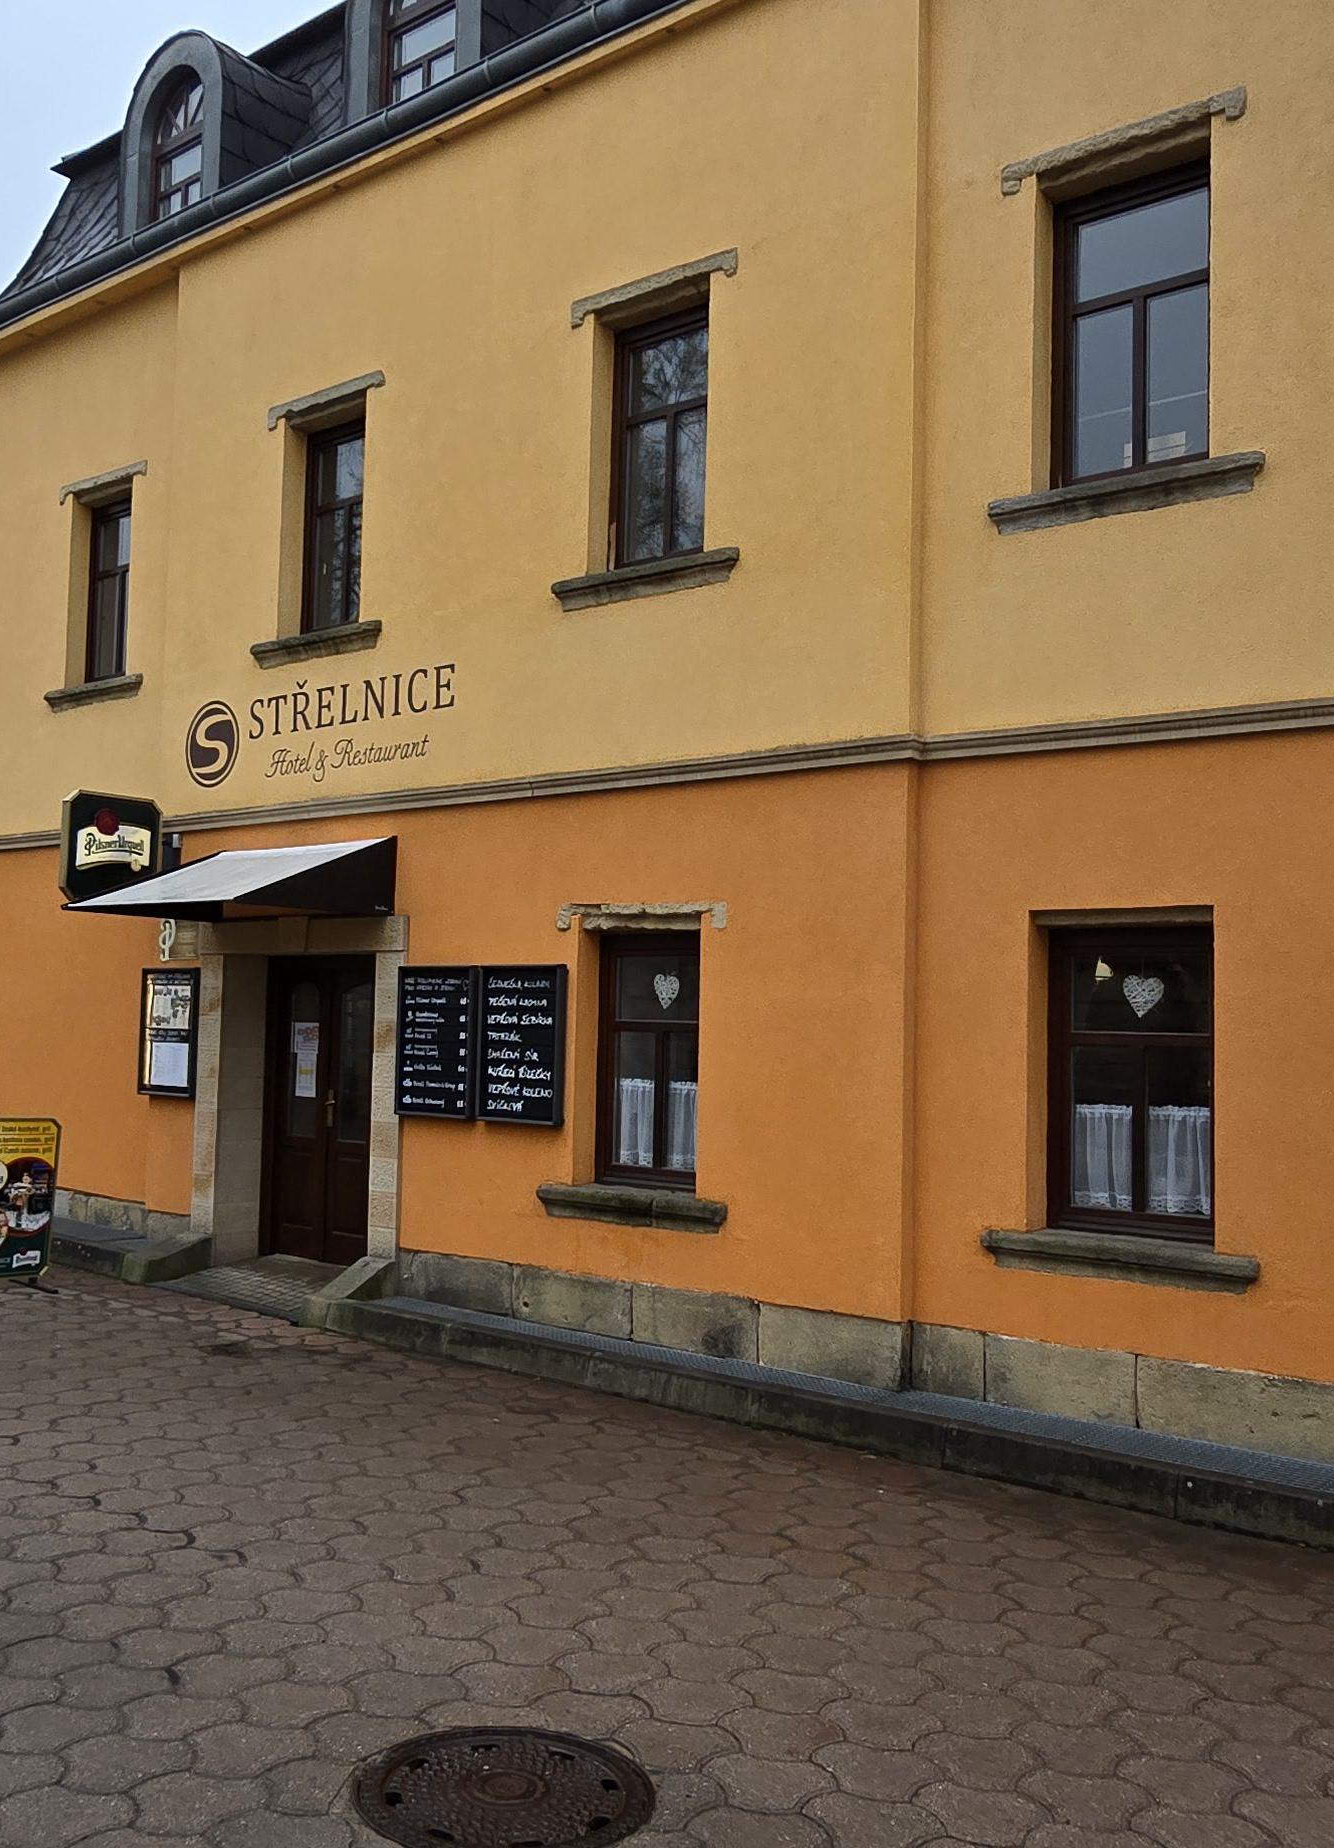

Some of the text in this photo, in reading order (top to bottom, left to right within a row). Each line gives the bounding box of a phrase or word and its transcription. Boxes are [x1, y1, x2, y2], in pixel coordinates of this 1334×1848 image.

[249, 664, 455, 739] STŘELNICE
[265, 734, 429, 782] Hotel & Restaurant
[84, 833, 144, 856] Pilsner Urquell
